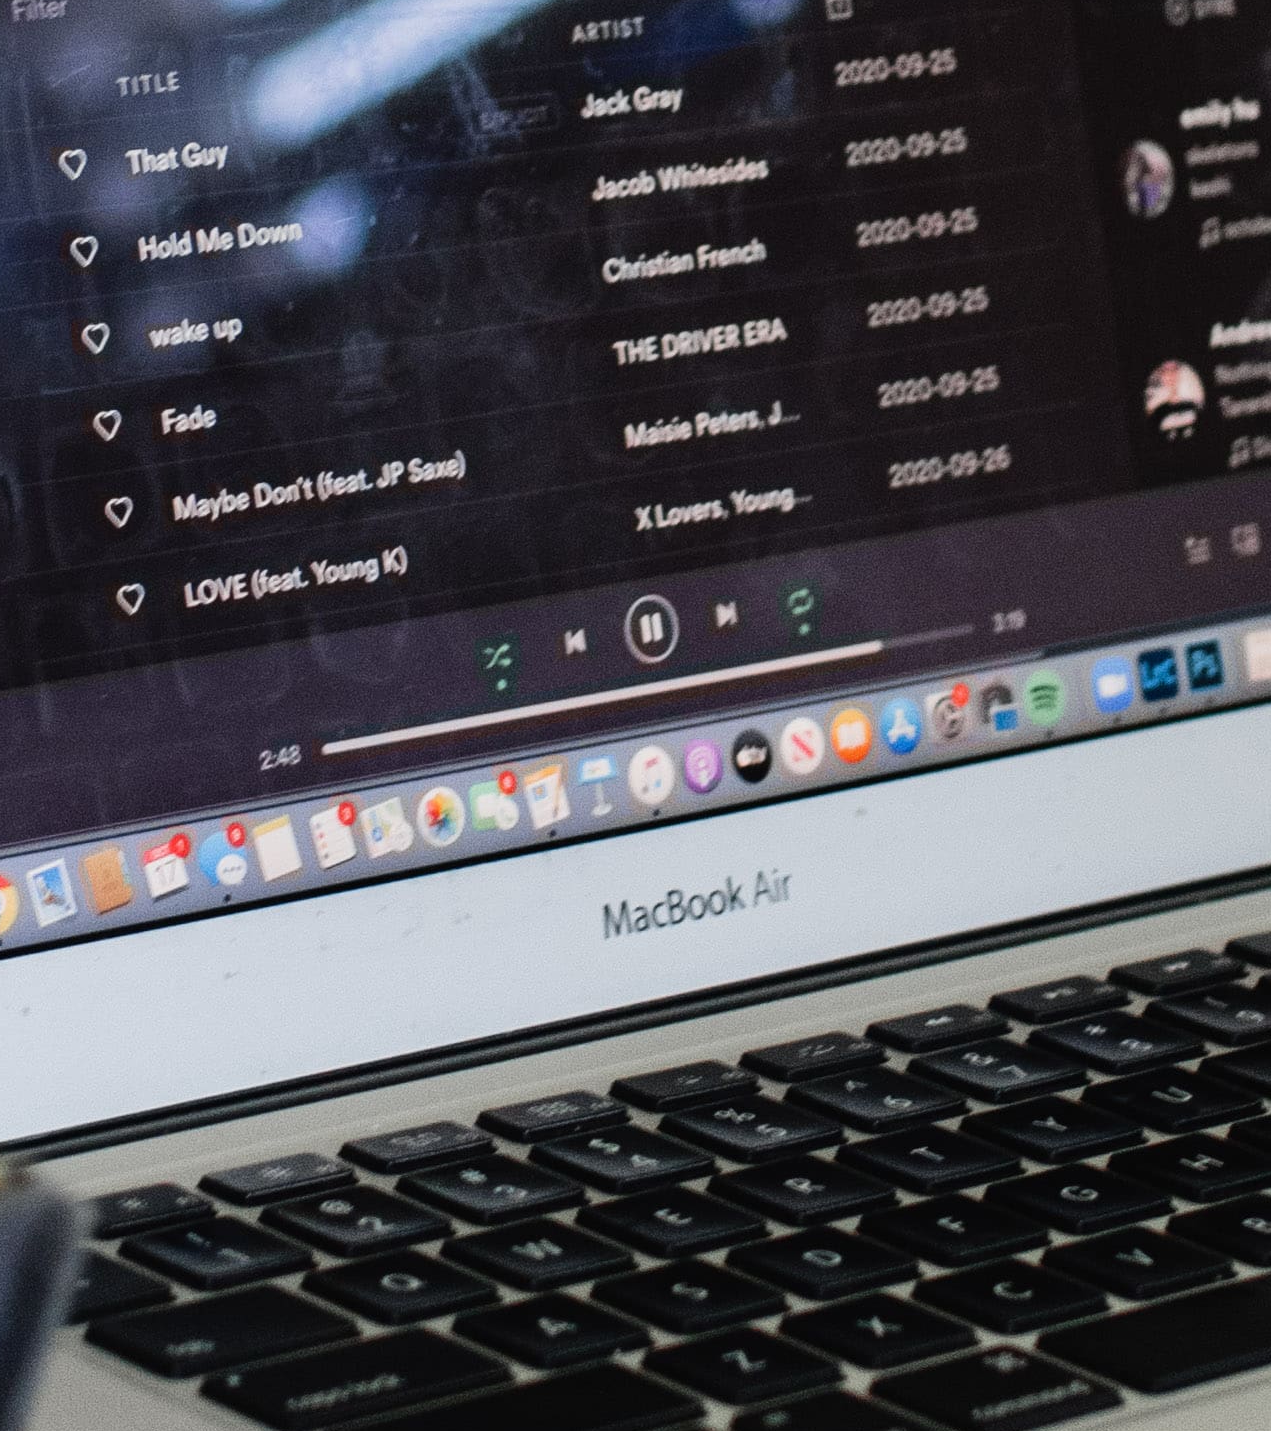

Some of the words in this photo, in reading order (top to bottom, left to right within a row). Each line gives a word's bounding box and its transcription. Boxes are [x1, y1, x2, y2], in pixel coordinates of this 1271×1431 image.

[571, 15, 646, 44] ARTIST
[116, 71, 181, 99] TITLE
[834, 48, 958, 87] 2020-09-25
[580, 92, 631, 120] Jack
[633, 85, 683, 114] Gray
[126, 146, 180, 175] That
[182, 140, 229, 173] Guy
[845, 127, 968, 168] 2020-09-25
[592, 169, 656, 202] Jacob
[658, 156, 770, 192] Whitesides
[137, 230, 192, 262] Hold
[195, 226, 234, 255] Me
[237, 220, 303, 249] Down
[857, 206, 979, 249] 2020-09-25
[603, 251, 696, 284] Christian
[697, 238, 767, 271] French
[867, 286, 991, 328] 2020-09-25
[149, 318, 211, 350] wake
[214, 315, 243, 344] up
[613, 336, 660, 366] THE
[661, 324, 741, 360] DRIVER
[742, 317, 789, 347] ERA
[160, 403, 217, 436] Fade
[624, 420, 693, 450] Maisie
[694, 406, 765, 440] Peters,
[172, 489, 250, 523] Maybe
[253, 477, 314, 511] Don't
[316, 468, 374, 503] (feat.
[375, 461, 405, 490] JP
[406, 449, 467, 482] Saxe)
[635, 504, 653, 532] X
[654, 494, 729, 530] Lovers,
[183, 574, 249, 609] LOVE
[251, 562, 308, 599] (feat.
[308, 554, 381, 588] Young
[382, 544, 409, 574] K)
[602, 879, 746, 940] MacBook
[753, 869, 792, 905] Air
